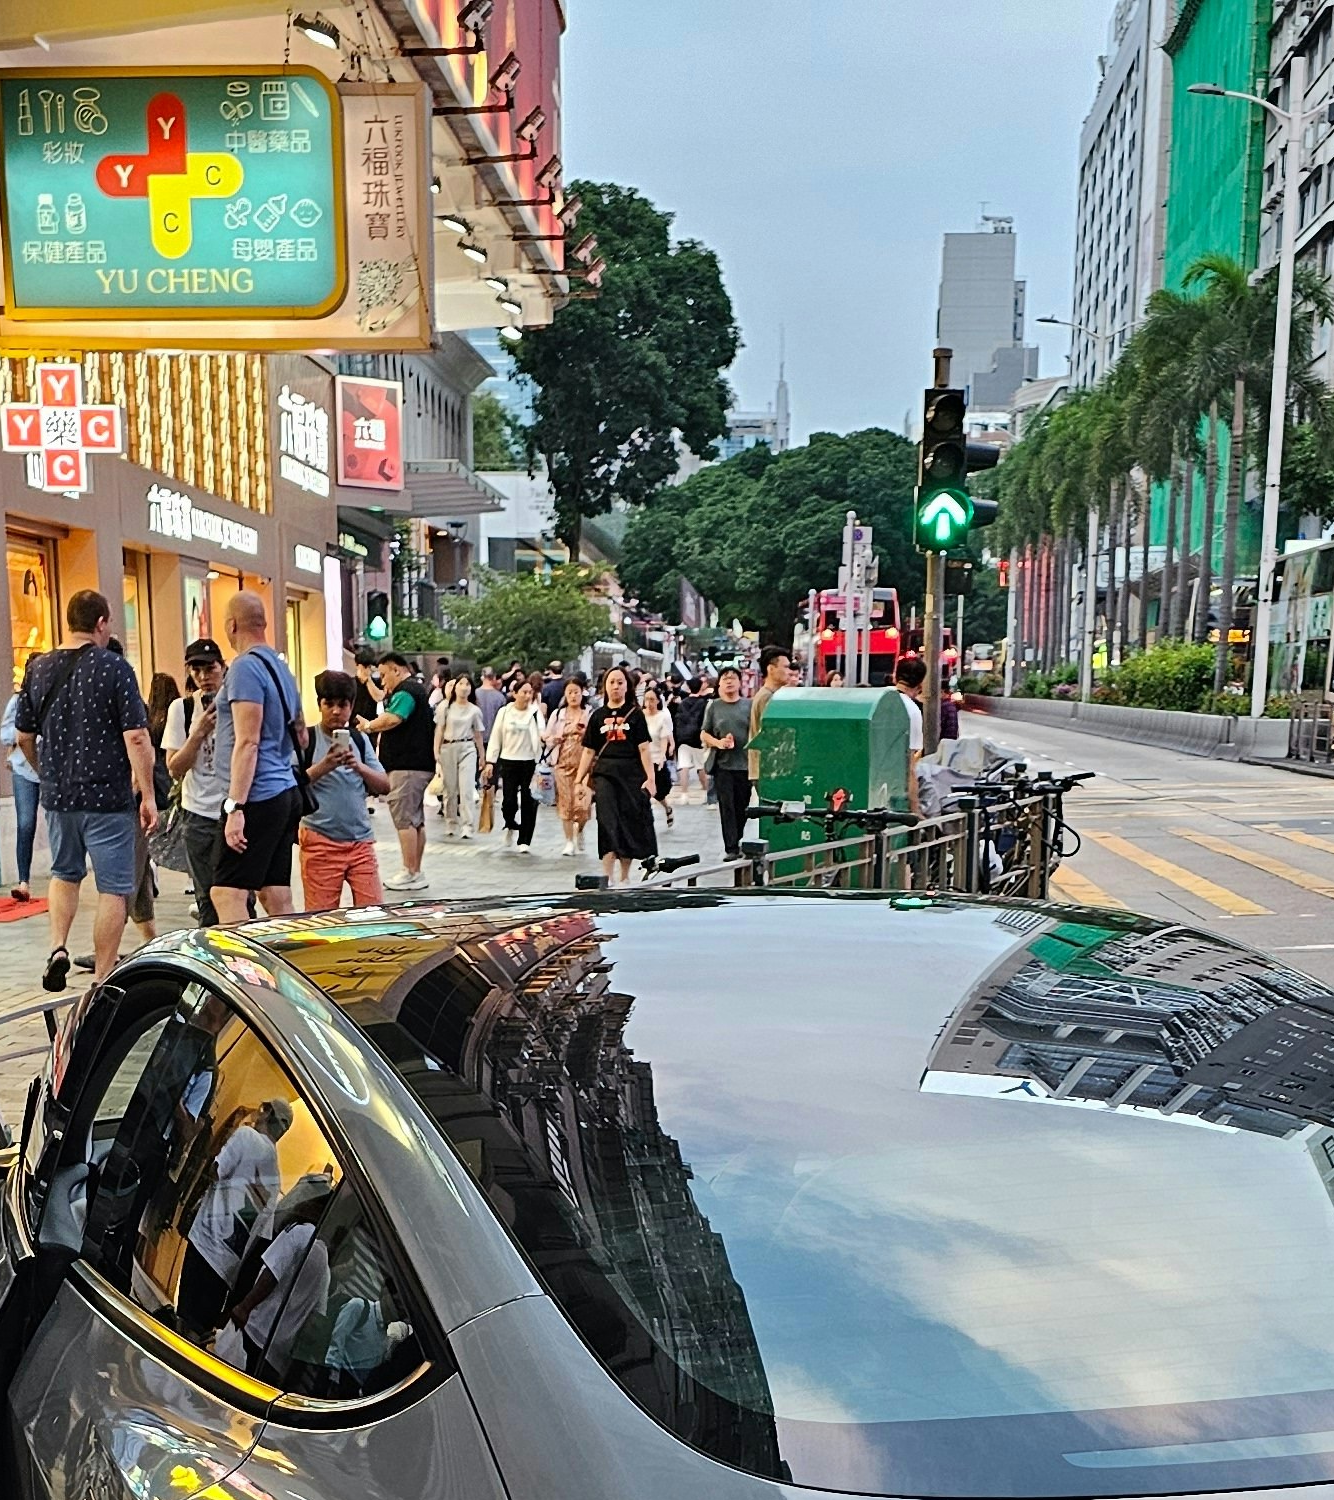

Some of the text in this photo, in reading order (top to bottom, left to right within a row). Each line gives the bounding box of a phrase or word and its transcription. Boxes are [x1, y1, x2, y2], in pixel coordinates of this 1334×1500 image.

[157, 116, 176, 140] Y
[43, 141, 84, 164] 彩妝
[225, 130, 311, 154] 中醫藥品
[115, 165, 134, 188] Y
[205, 166, 221, 186] C
[361, 114, 391, 240] 六福珠寶
[163, 212, 179, 233] C
[22, 240, 107, 264] 保健產品
[232, 238, 318, 262] 母嬰產品
[95, 268, 255, 294] YU CHENG
[46, 375, 69, 395] Y
[12, 415, 34, 441] Y
[87, 414, 110, 436] C
[53, 455, 76, 481] C
